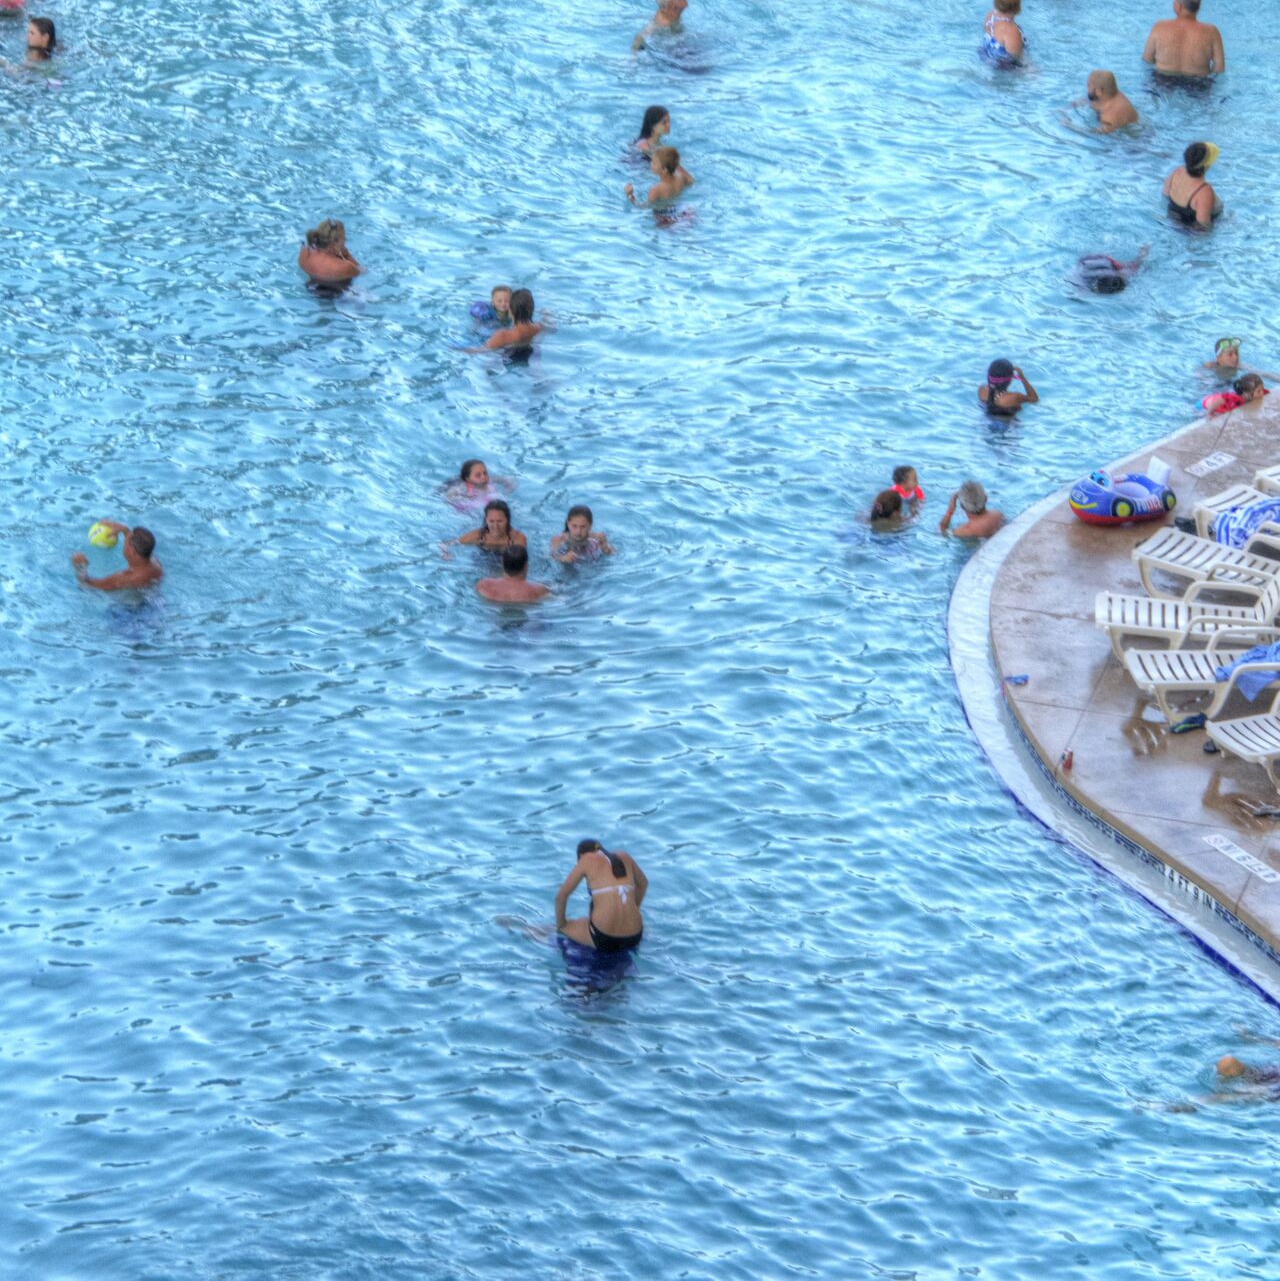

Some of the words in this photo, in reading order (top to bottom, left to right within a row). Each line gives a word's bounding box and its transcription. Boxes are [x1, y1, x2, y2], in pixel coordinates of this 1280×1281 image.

[1167, 868, 1175, 883] 4
[1178, 874, 1190, 893] FT
[1192, 886, 1199, 901] 9
[1202, 891, 1213, 910] IN
